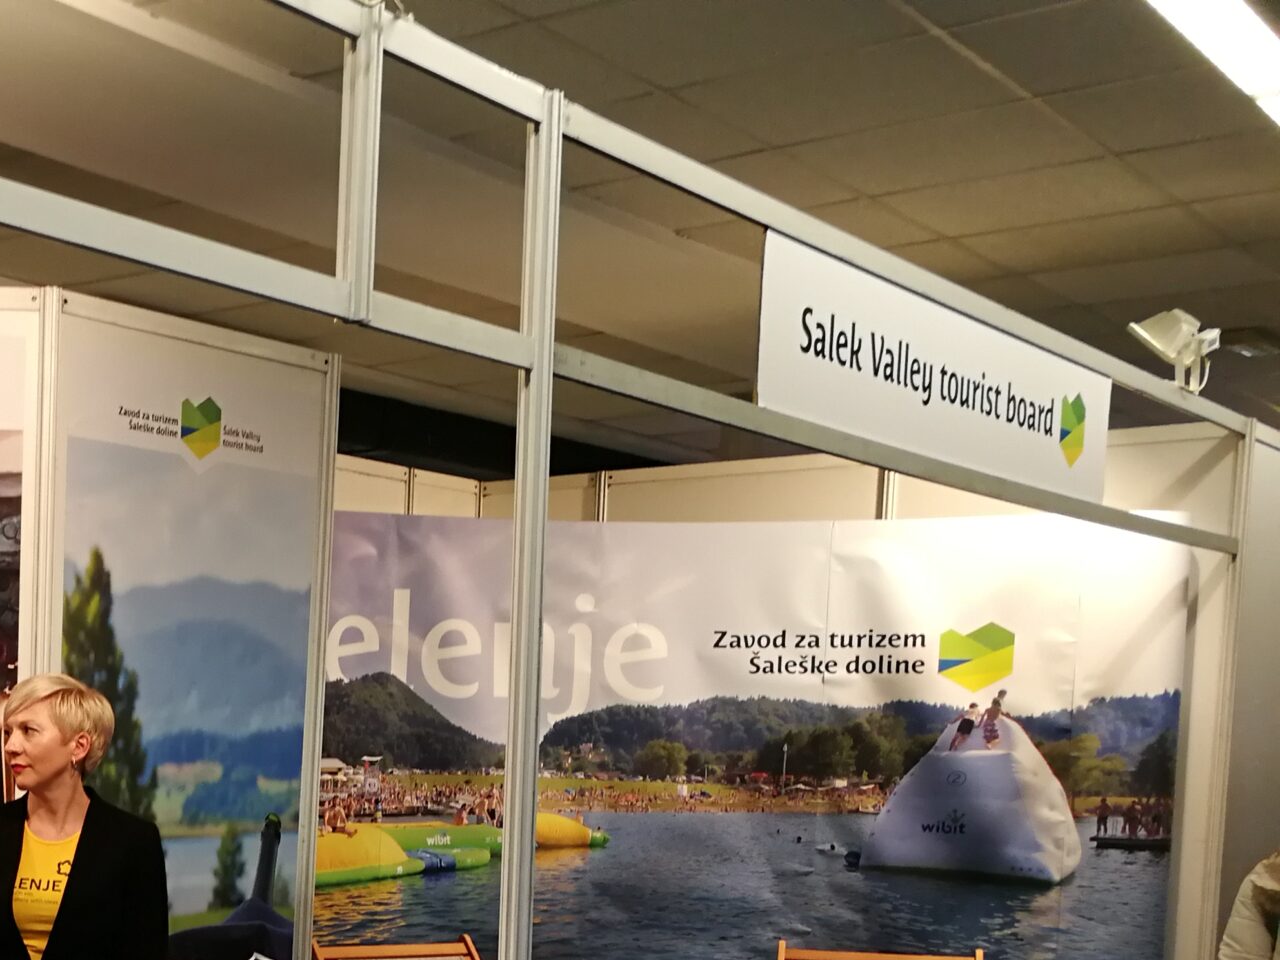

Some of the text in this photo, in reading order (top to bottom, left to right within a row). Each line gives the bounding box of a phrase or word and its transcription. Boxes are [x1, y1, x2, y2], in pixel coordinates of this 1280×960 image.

[800, 307, 1054, 437] Salek Valley tourist board
[119, 406, 141, 419] Zavod
[151, 413, 179, 426] turizem
[156, 425, 178, 438] doline
[713, 629, 926, 649] Zavod za turizem
[749, 651, 925, 675] Šaleške doline
[921, 820, 966, 835] wibit
